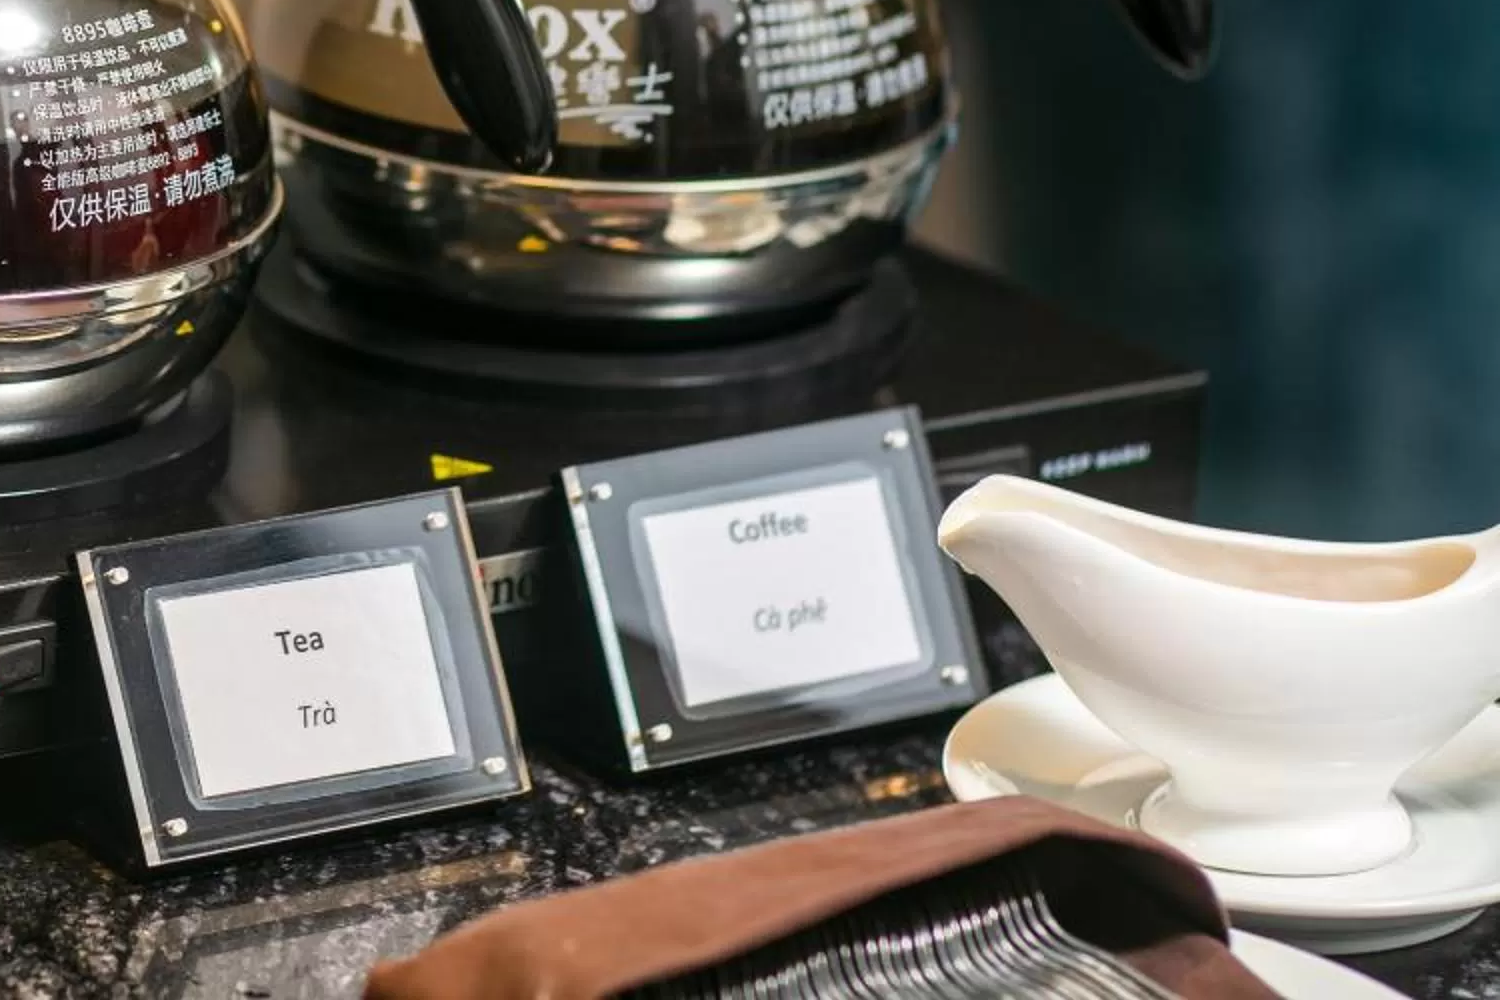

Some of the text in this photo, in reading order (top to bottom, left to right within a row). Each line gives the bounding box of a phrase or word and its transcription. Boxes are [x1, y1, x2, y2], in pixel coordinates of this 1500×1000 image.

[728, 511, 808, 544] Coffee
[753, 604, 781, 632] Cà
[274, 630, 325, 655] Tea
[297, 700, 337, 729] Trà
